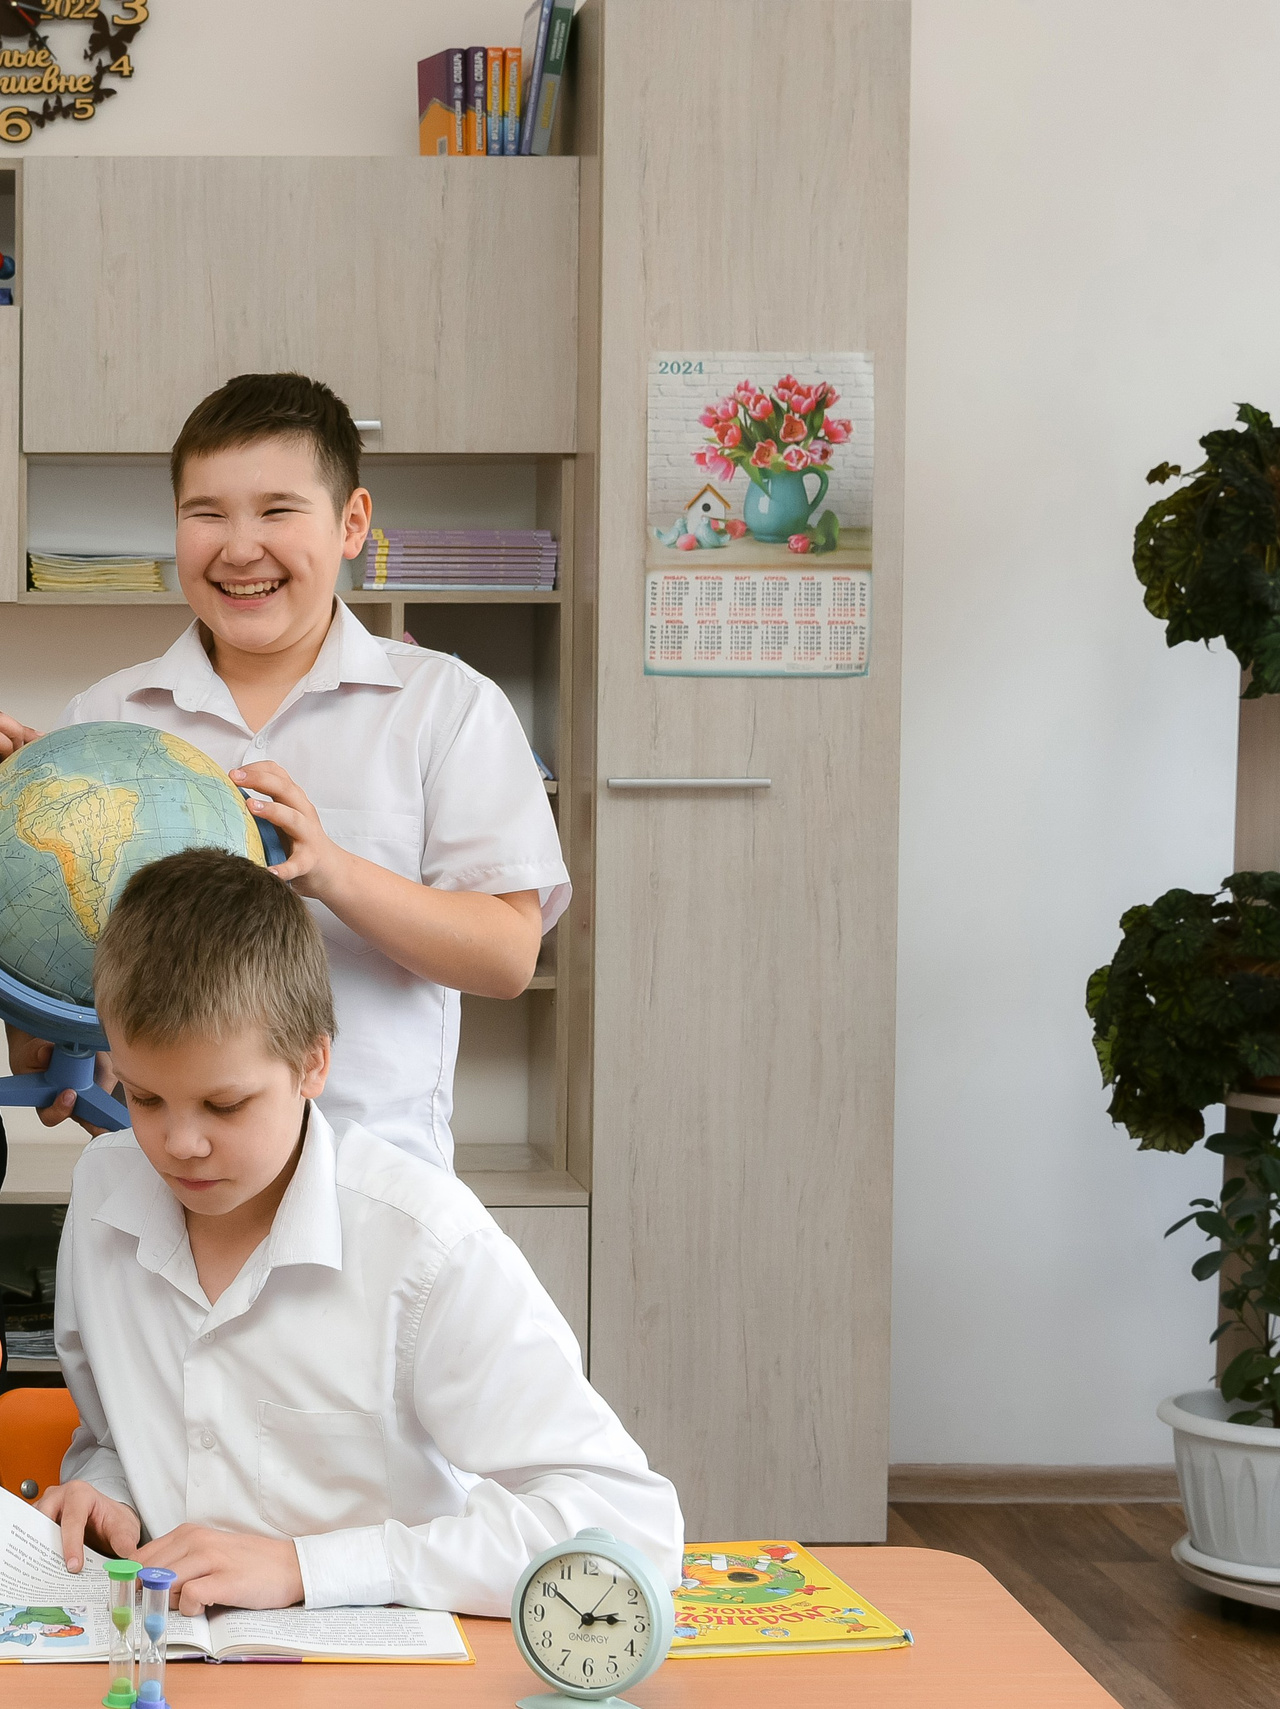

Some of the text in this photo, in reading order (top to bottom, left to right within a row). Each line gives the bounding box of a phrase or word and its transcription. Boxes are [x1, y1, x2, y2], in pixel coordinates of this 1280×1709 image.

[109, 54, 135, 78] 4
[453, 53, 463, 84] СЛОВАРЬ
[474, 51, 484, 82] СЛОВАРЬ
[73, 98, 95, 120] 5
[658, 361, 704, 375] 2024
[560, 1564, 572, 1580] 11
[583, 1559, 599, 1576] 12
[612, 1568, 618, 1584] 1
[542, 1582, 558, 1598] 10
[627, 1588, 638, 1605] 2
[533, 1604, 545, 1622] 9
[703, 1604, 792, 1616] БЫЧОК
[634, 1615, 646, 1633] 3
[541, 1630, 552, 1648] 8
[624, 1638, 636, 1657] 4
[560, 1649, 572, 1666] 7
[606, 1655, 618, 1674] 5
[582, 1658, 594, 1677] 6
